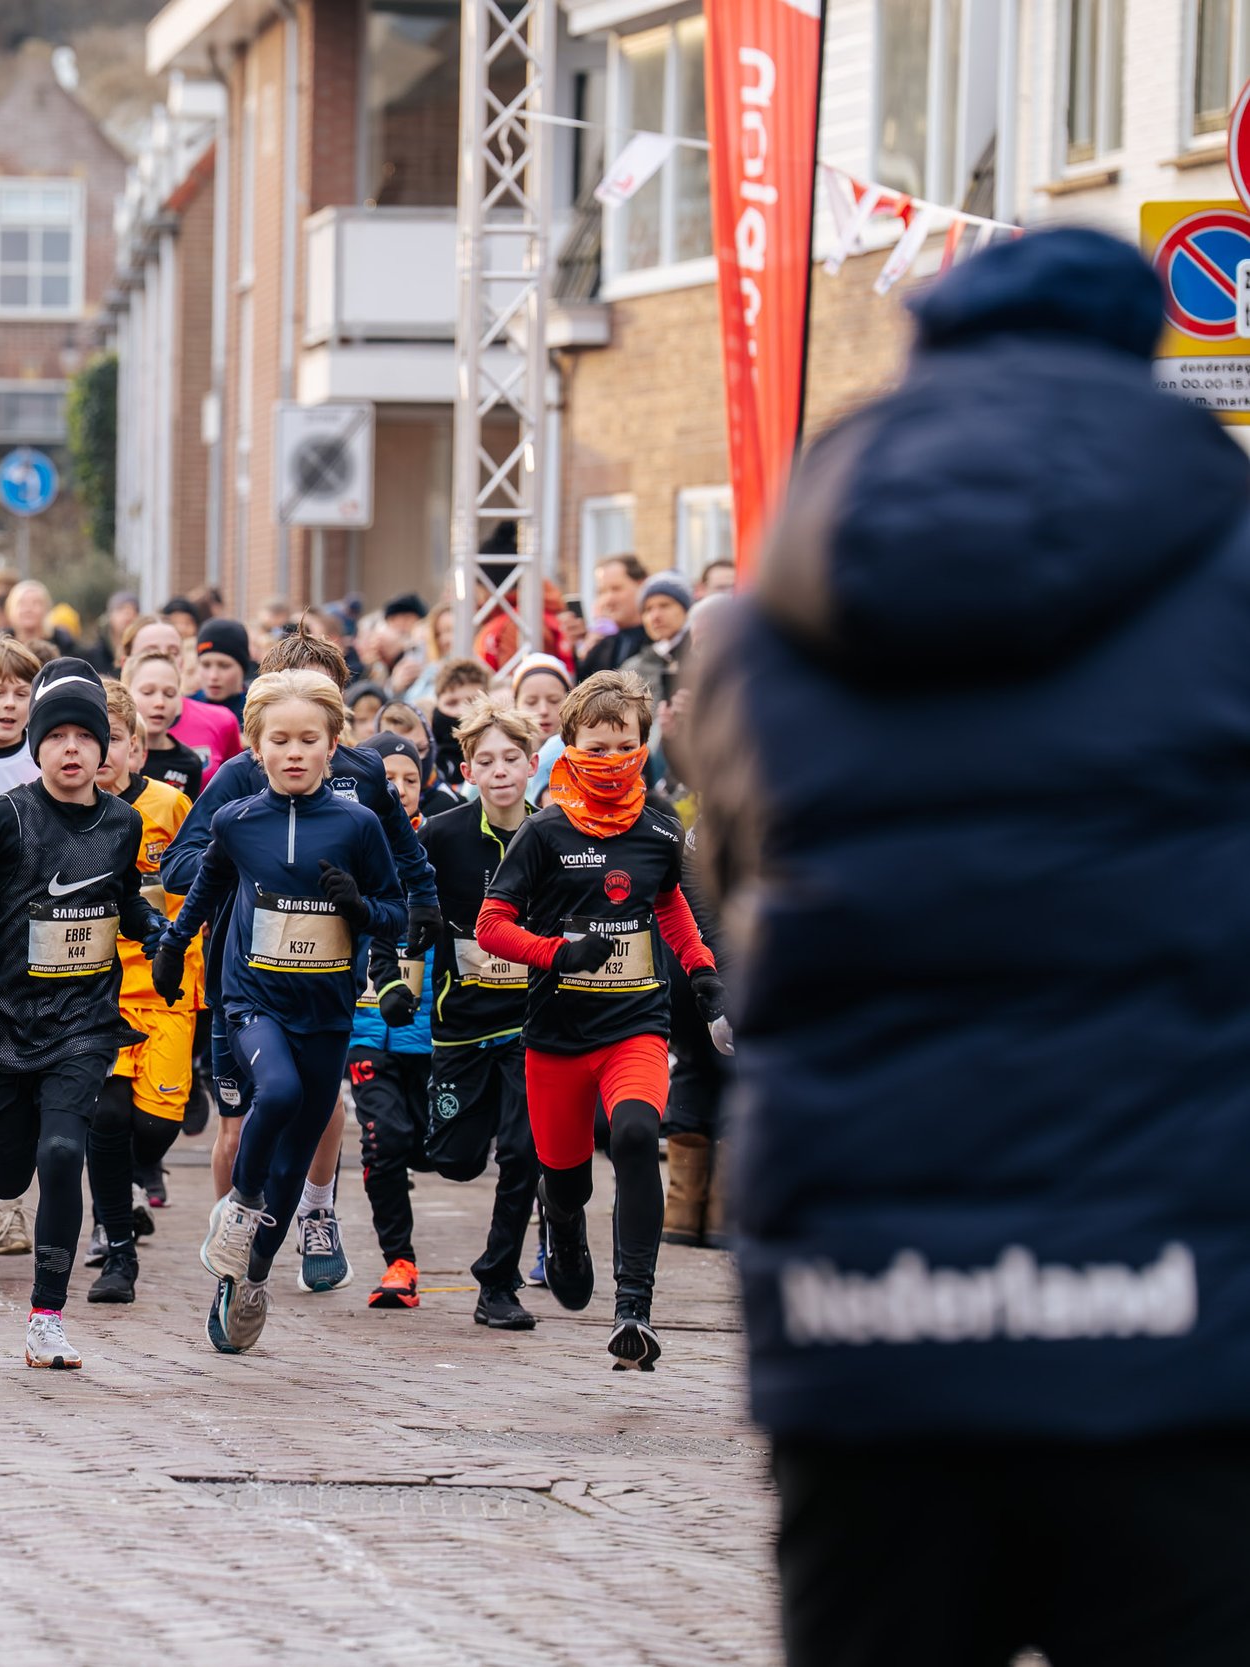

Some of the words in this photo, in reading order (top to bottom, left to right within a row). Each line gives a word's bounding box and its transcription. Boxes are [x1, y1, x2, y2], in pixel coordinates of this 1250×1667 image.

[652, 825, 674, 839] CRAFT
[560, 847, 607, 865] vanhier
[277, 898, 336, 912] SAMSUNG
[52, 906, 105, 919] SAMSUNG
[589, 920, 639, 932] SAMSUNG
[65, 927, 92, 943] EBBE
[68, 946, 86, 958] K44
[290, 941, 316, 954] K377
[253, 955, 278, 965] EGMOND
[31, 964, 56, 972] EGMOND
[491, 963, 511, 973] K101
[605, 962, 623, 974] K32
[562, 978, 590, 987] EGMOND
[611, 979, 640, 987] MARATHON
[782, 1241, 1198, 1345] Nederland
